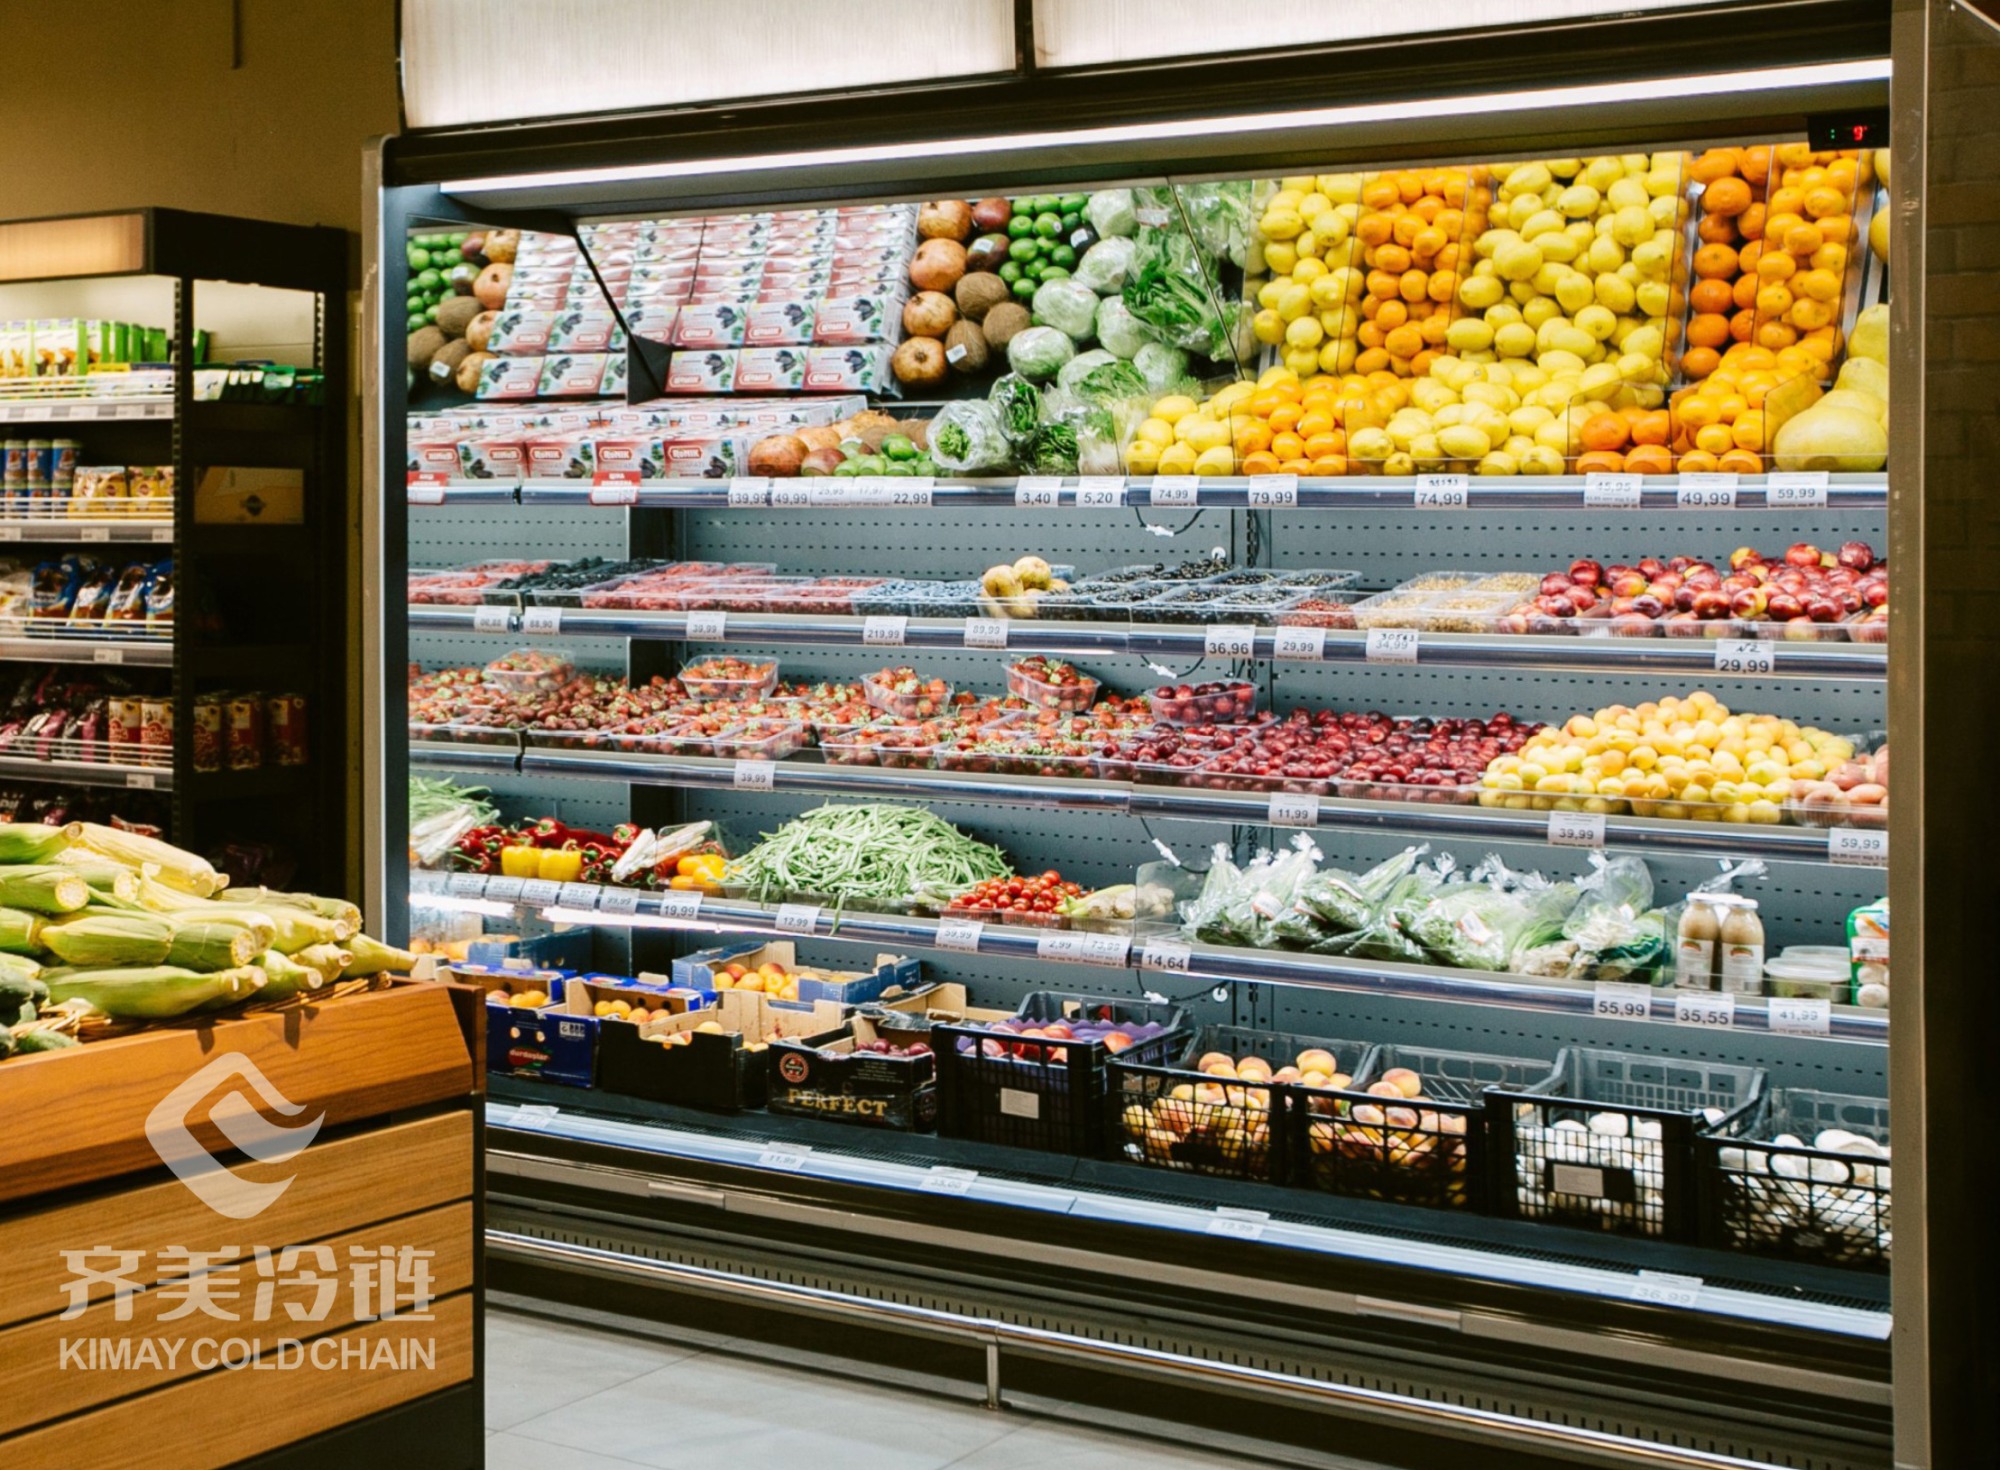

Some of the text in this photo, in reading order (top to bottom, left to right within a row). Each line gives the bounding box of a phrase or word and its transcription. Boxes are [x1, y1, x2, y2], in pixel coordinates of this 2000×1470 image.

[775, 493, 807, 505] 49,99
[893, 493, 928, 505] 22,99
[1022, 491, 1051, 505] 3,40
[1084, 491, 1113, 505] 5,20
[1158, 489, 1188, 500] 74,99
[1252, 491, 1293, 505] 79,99
[1419, 493, 1462, 506] 74,99
[1682, 492, 1730, 507] 49,99
[1778, 487, 1816, 500] 59,99
[868, 629, 899, 640] 219,99
[1209, 642, 1249, 655] 36,96
[1283, 642, 1314, 653] 29,99
[1720, 658, 1769, 673] 29,99
[1278, 808, 1309, 819] 11,99
[1559, 828, 1594, 840] 39,99
[1841, 838, 1880, 850] 59,99
[664, 905, 695, 917] 19,99
[784, 917, 809, 927] 12,99
[1147, 954, 1184, 969] 14,64
[1598, 1001, 1645, 1016] 55,99
[1680, 1008, 1729, 1025] 35,55
[787, 1088, 888, 1116] PERFECT
